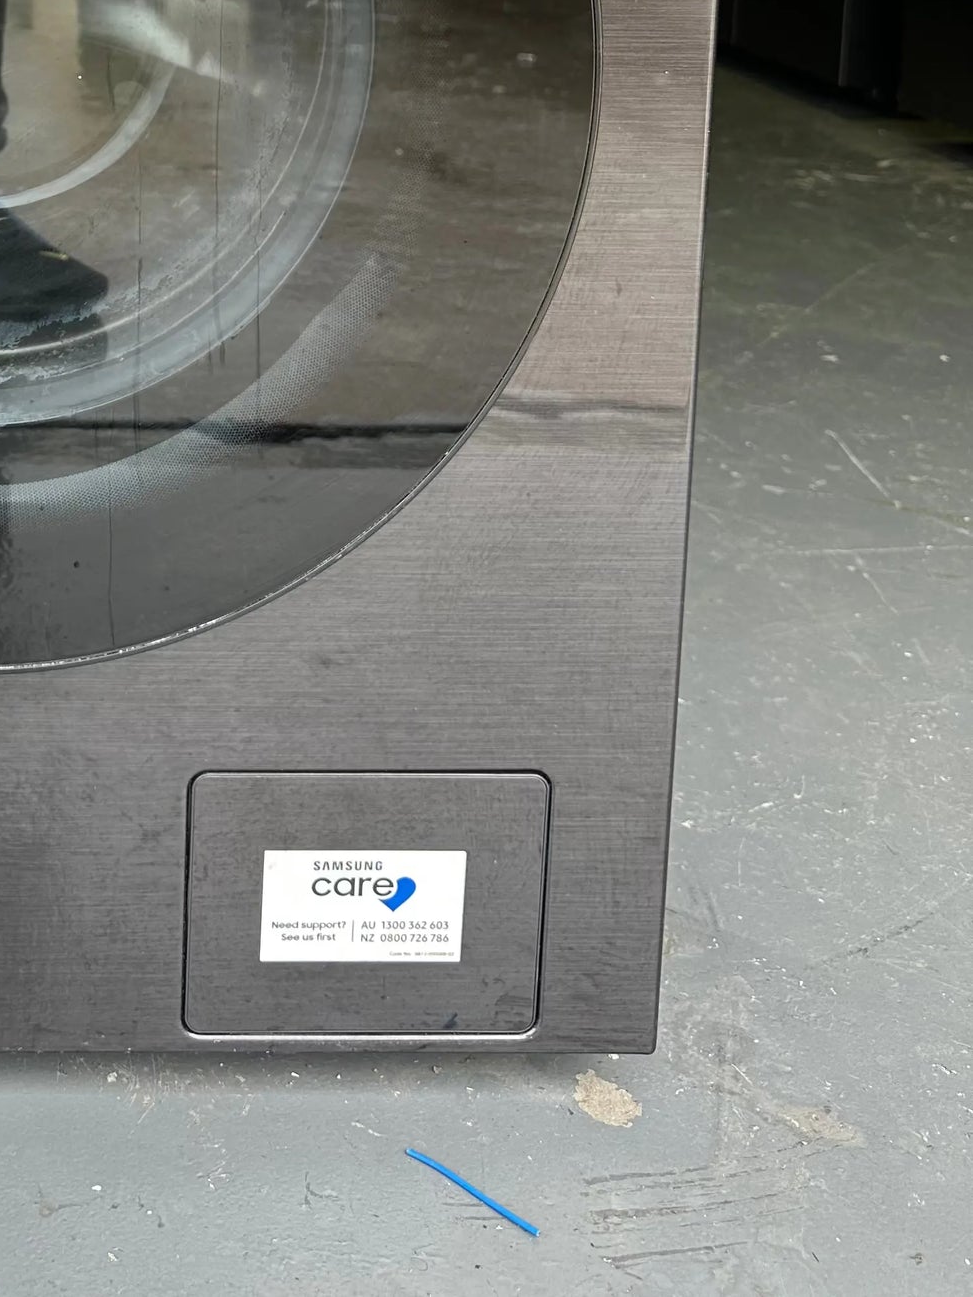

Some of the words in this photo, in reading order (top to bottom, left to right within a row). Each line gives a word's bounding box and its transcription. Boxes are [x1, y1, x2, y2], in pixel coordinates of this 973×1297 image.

[313, 860, 383, 871] SAMSUNG
[311, 876, 394, 897] care
[271, 921, 299, 930] Need
[301, 921, 346, 931] support?
[361, 921, 376, 930] AU
[382, 921, 406, 930] 1300
[408, 921, 427, 930] 362
[430, 921, 449, 930] 603
[281, 933, 299, 941] See
[302, 934, 314, 942] us
[316, 933, 336, 942] first
[360, 934, 375, 943] NZ
[380, 934, 407, 943] 0800
[409, 934, 427, 943] 726
[430, 934, 449, 943] 786
